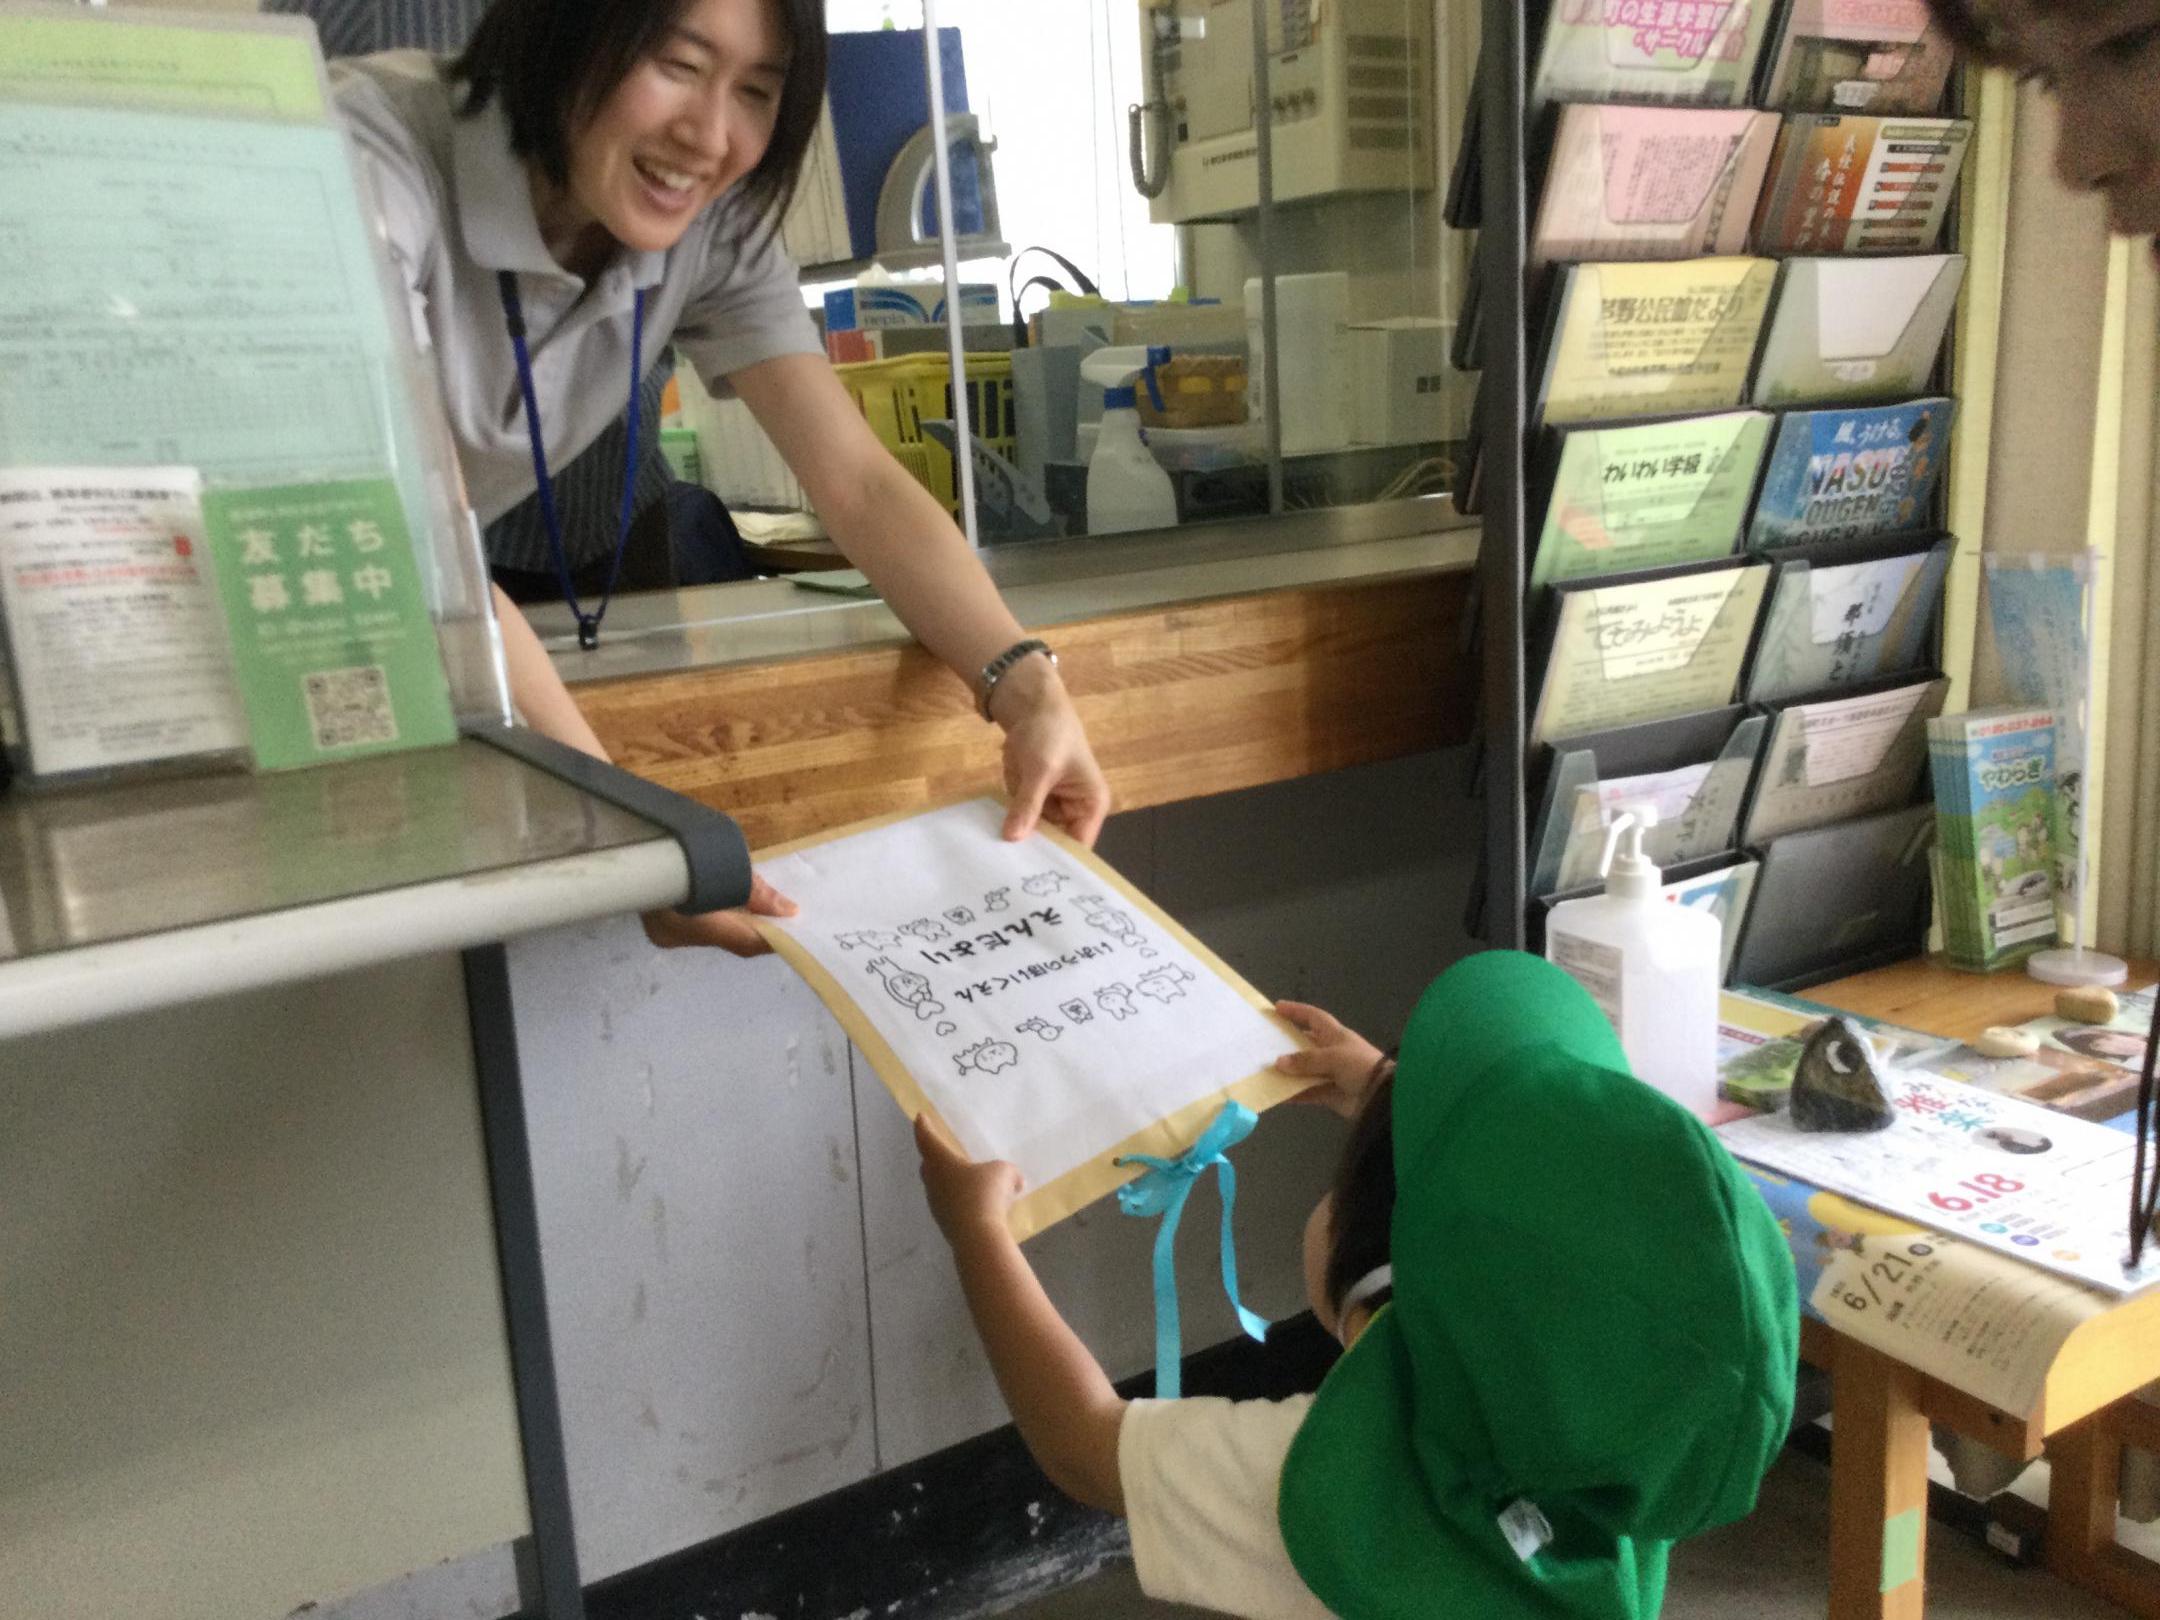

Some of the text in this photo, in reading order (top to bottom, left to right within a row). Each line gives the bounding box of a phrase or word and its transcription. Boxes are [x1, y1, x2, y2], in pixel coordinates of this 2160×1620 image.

[237, 518, 384, 566] 友だち
[246, 564, 392, 614] 募集中
[1980, 756, 2043, 789] やわらぎ
[919, 907, 1063, 964] えんだより
[1927, 1172, 2025, 1212] 6.18
[1842, 1251, 1912, 1311] 6/21
